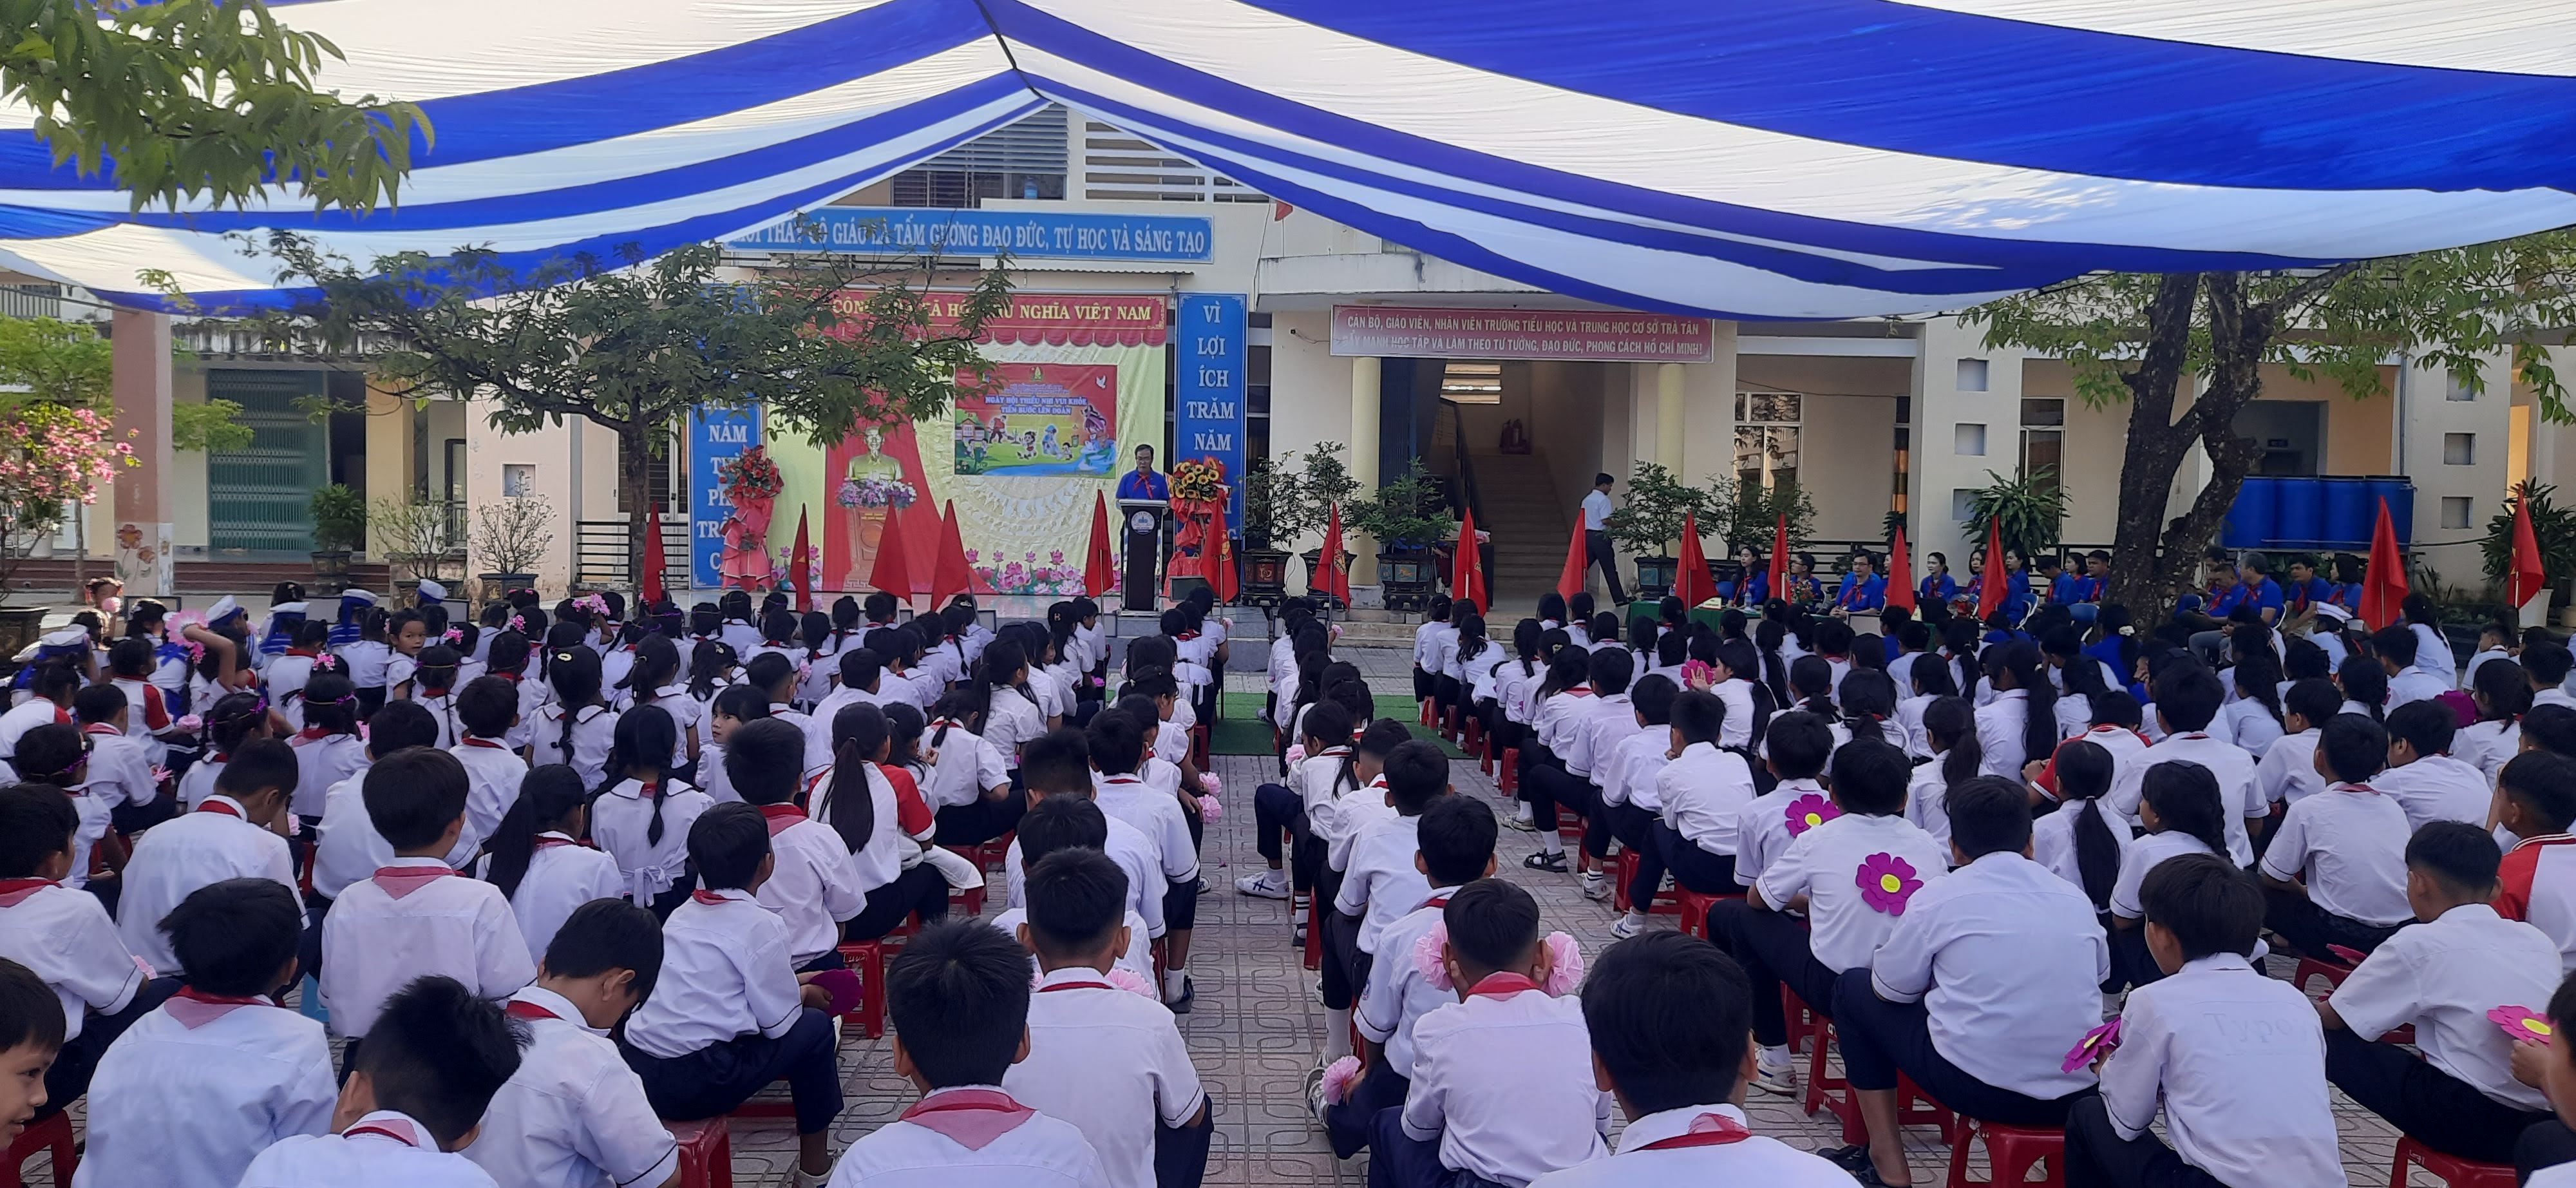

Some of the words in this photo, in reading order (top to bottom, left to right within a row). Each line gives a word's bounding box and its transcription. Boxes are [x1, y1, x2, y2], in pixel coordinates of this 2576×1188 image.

[833, 216, 867, 245] GIÁO
[894, 213, 925, 245] TẤM
[929, 220, 978, 247] GƯƠNG
[982, 225, 1011, 252] ĐẠO
[1016, 220, 1049, 251] ĐỨC,
[1054, 224, 1074, 254] TỰ
[1077, 227, 1107, 254] HỌC
[1111, 223, 1130, 251] VÀ
[1135, 224, 1172, 253] SÁNG
[1176, 231, 1204, 258] TẠO
[832, 296, 875, 314] CÔN
[1019, 302, 1070, 320] NGHĨA
[1074, 302, 1112, 323] VIỆT
[1117, 306, 1151, 320] NAM
[1202, 301, 1221, 323] VÌ
[1347, 313, 1365, 328] CÁN
[1368, 315, 1383, 331] BỘ,
[1385, 314, 1406, 329] GIÁO
[1409, 315, 1432, 331] VIÊN,
[1434, 315, 1459, 331] NHÂN
[1461, 316, 1481, 331] VIÊN
[1484, 316, 1520, 332] TRƯỜNG
[1522, 315, 1542, 332] TIỂU
[1546, 320, 1563, 335] HỌC
[1566, 318, 1577, 332] VÀ
[1580, 321, 1609, 334] TRUNG
[1611, 321, 1629, 336] HỌC
[1632, 320, 1645, 334] CƠ
[1646, 320, 1658, 334] SỞ
[1681, 320, 1699, 335] TÂN
[1197, 334, 1226, 359] LỢI
[1432, 335, 1444, 349] VÀ
[1446, 334, 1465, 350] LÀM
[1468, 338, 1491, 350] THEO
[1493, 338, 1506, 350] TƯ
[1508, 335, 1539, 352] TƯỞNG,
[1542, 340, 1560, 354] ĐẠO
[1562, 338, 1583, 354] ĐỨC,
[1586, 340, 1616, 352] PHONG
[1618, 338, 1641, 353] CÁCH
[1643, 338, 1656, 354] HỒ
[1659, 340, 1674, 354] CHÍ
[1676, 341, 1702, 355] MINH!
[1198, 365, 1229, 387] ÍCH
[1186, 397, 1235, 419] TRĂM
[708, 421, 748, 443] NĂM
[1194, 428, 1231, 452] NĂM
